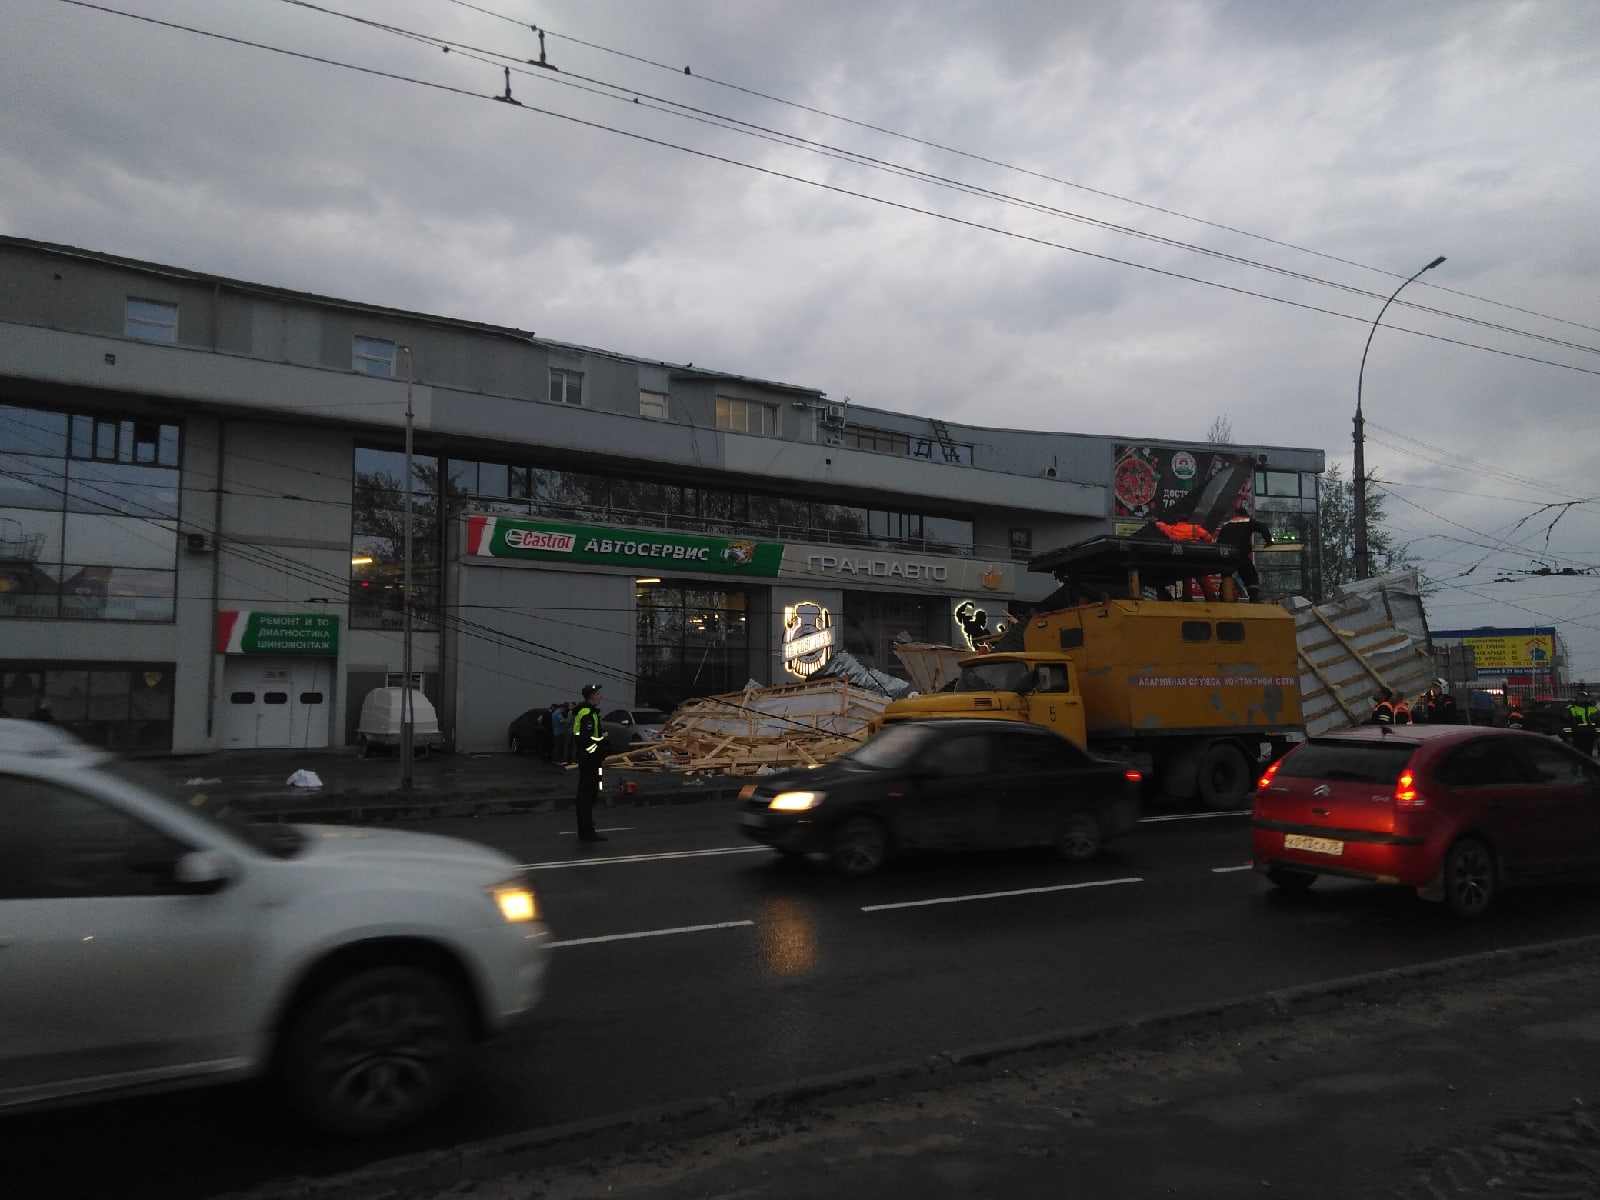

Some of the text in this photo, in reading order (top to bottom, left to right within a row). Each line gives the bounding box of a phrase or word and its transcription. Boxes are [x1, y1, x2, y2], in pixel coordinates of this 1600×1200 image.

[522, 531, 571, 550] Castrol
[583, 538, 710, 562] АВТОСЕРВИС
[260, 616, 329, 627] РЕМОНТ И ТО
[258, 627, 330, 639] ДИАГНОСТИКА
[257, 640, 330, 649] ШИНОМОНТАЖ
[1138, 677, 1296, 687] АВАРИЙНАЯ СЛУЖБА КОНТАКТНОЙ СЕТИ
[1049, 706, 1057, 722] 5
